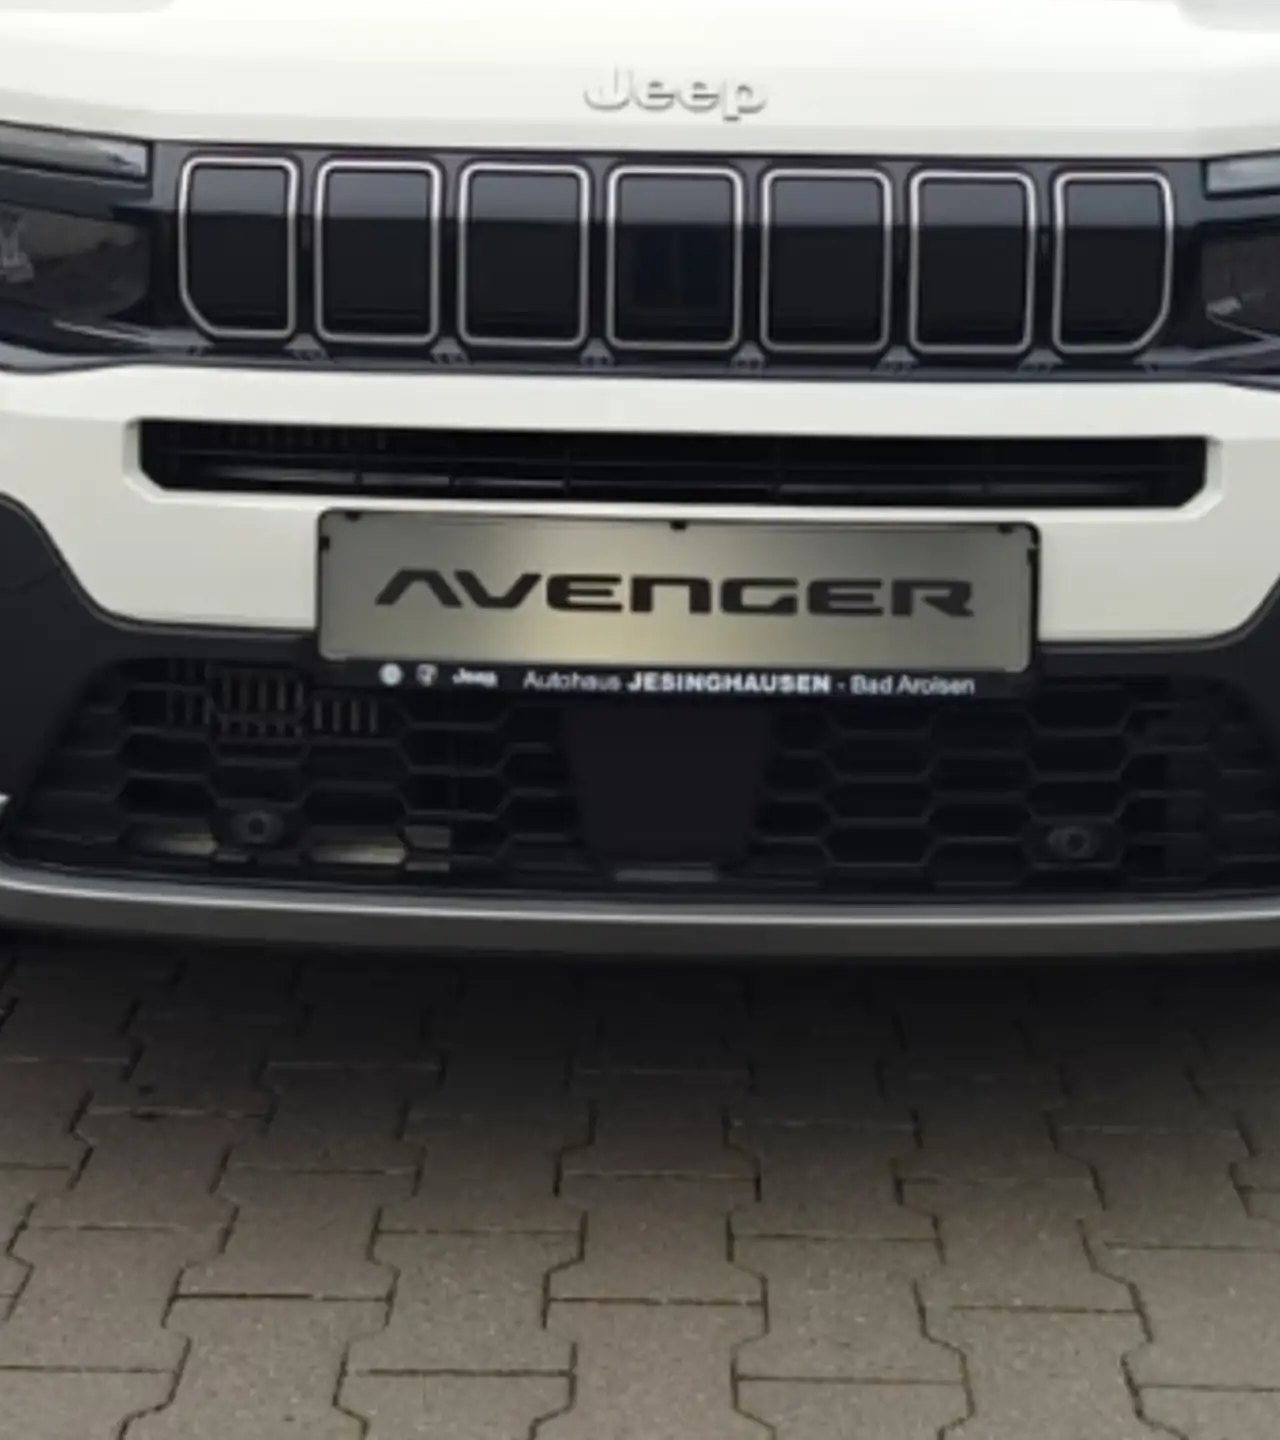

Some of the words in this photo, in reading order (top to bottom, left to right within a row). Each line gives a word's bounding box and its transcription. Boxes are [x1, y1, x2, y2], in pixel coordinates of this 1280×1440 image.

[583, 66, 768, 123] Jeep
[374, 568, 974, 618] AVENGER
[523, 670, 621, 692] Autohaus
[627, 671, 831, 695] JESINGHAUSEN
[850, 674, 893, 695] Bad
